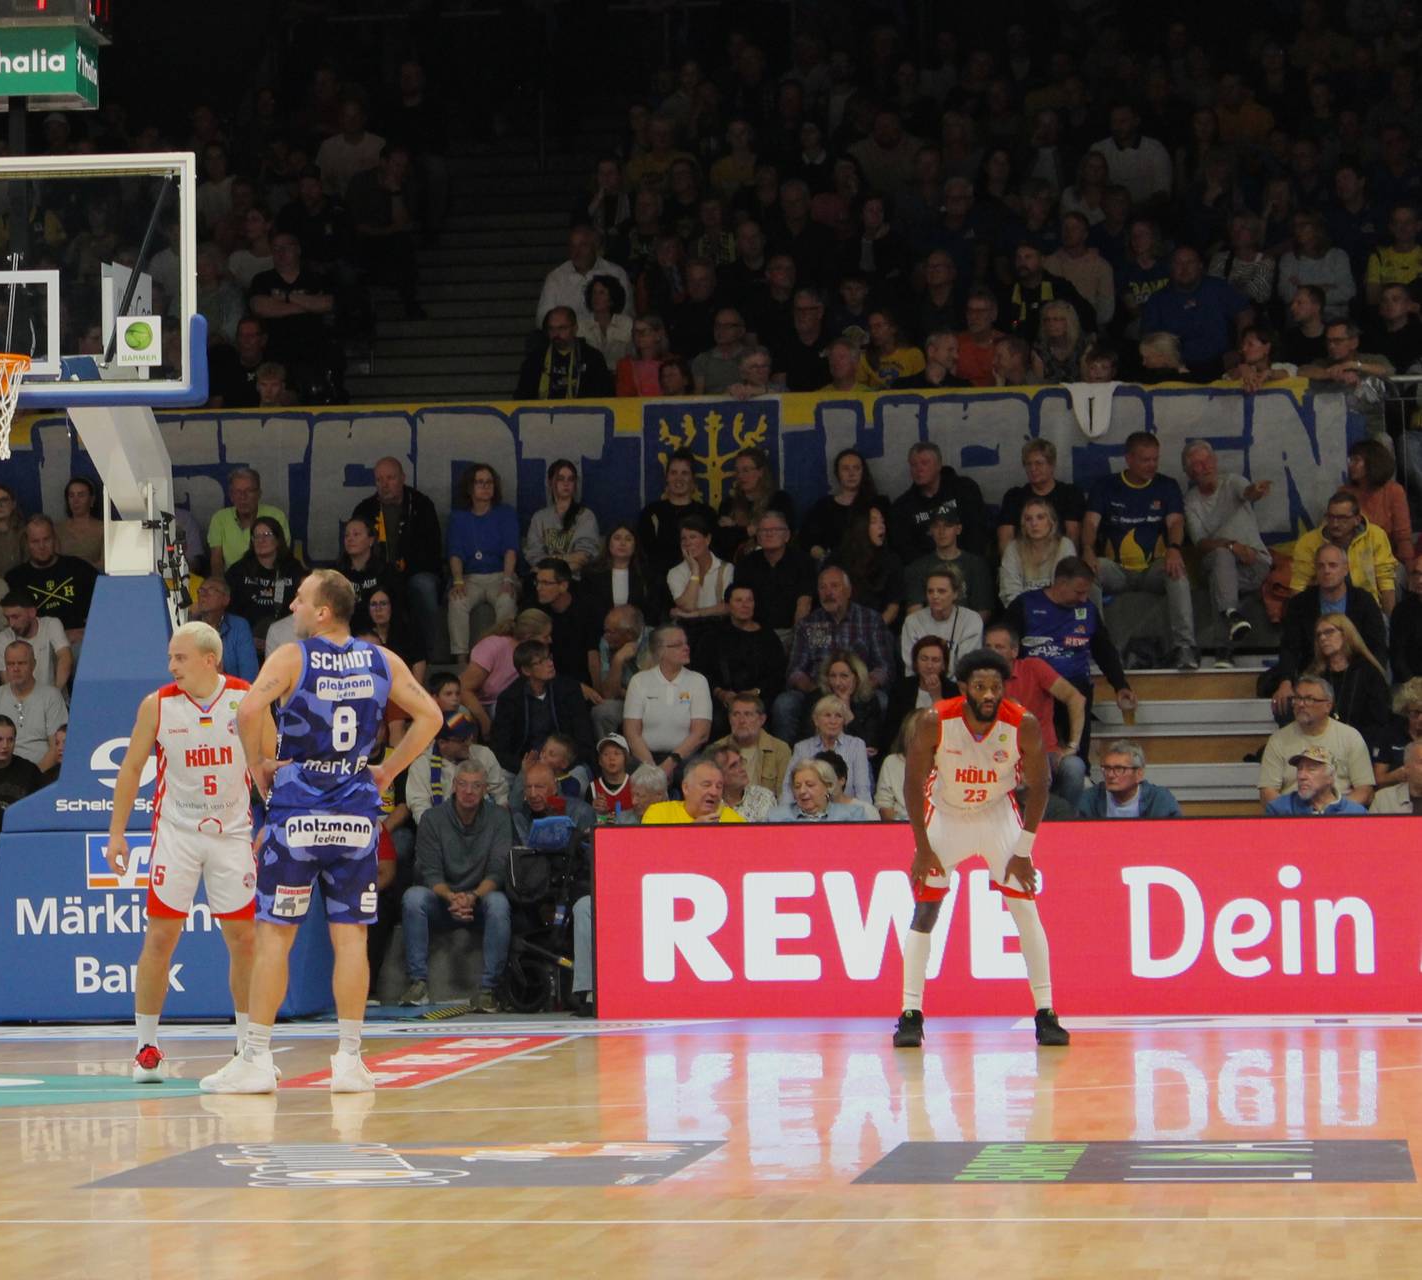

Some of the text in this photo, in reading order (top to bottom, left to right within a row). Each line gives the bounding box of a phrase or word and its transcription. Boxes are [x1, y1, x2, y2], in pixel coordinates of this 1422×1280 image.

[332, 706, 358, 752] 8
[185, 744, 232, 767] KÖLN
[303, 758, 351, 775] mark
[203, 774, 218, 796] 5
[955, 765, 998, 784] KÖLN
[962, 789, 988, 803] 23
[287, 819, 371, 838] platzmann
[313, 834, 347, 844] federn
[153, 864, 166, 887] 5
[15, 893, 224, 936] Märkih
[641, 864, 1377, 983] REWE Dein
[74, 956, 186, 994] Bak
